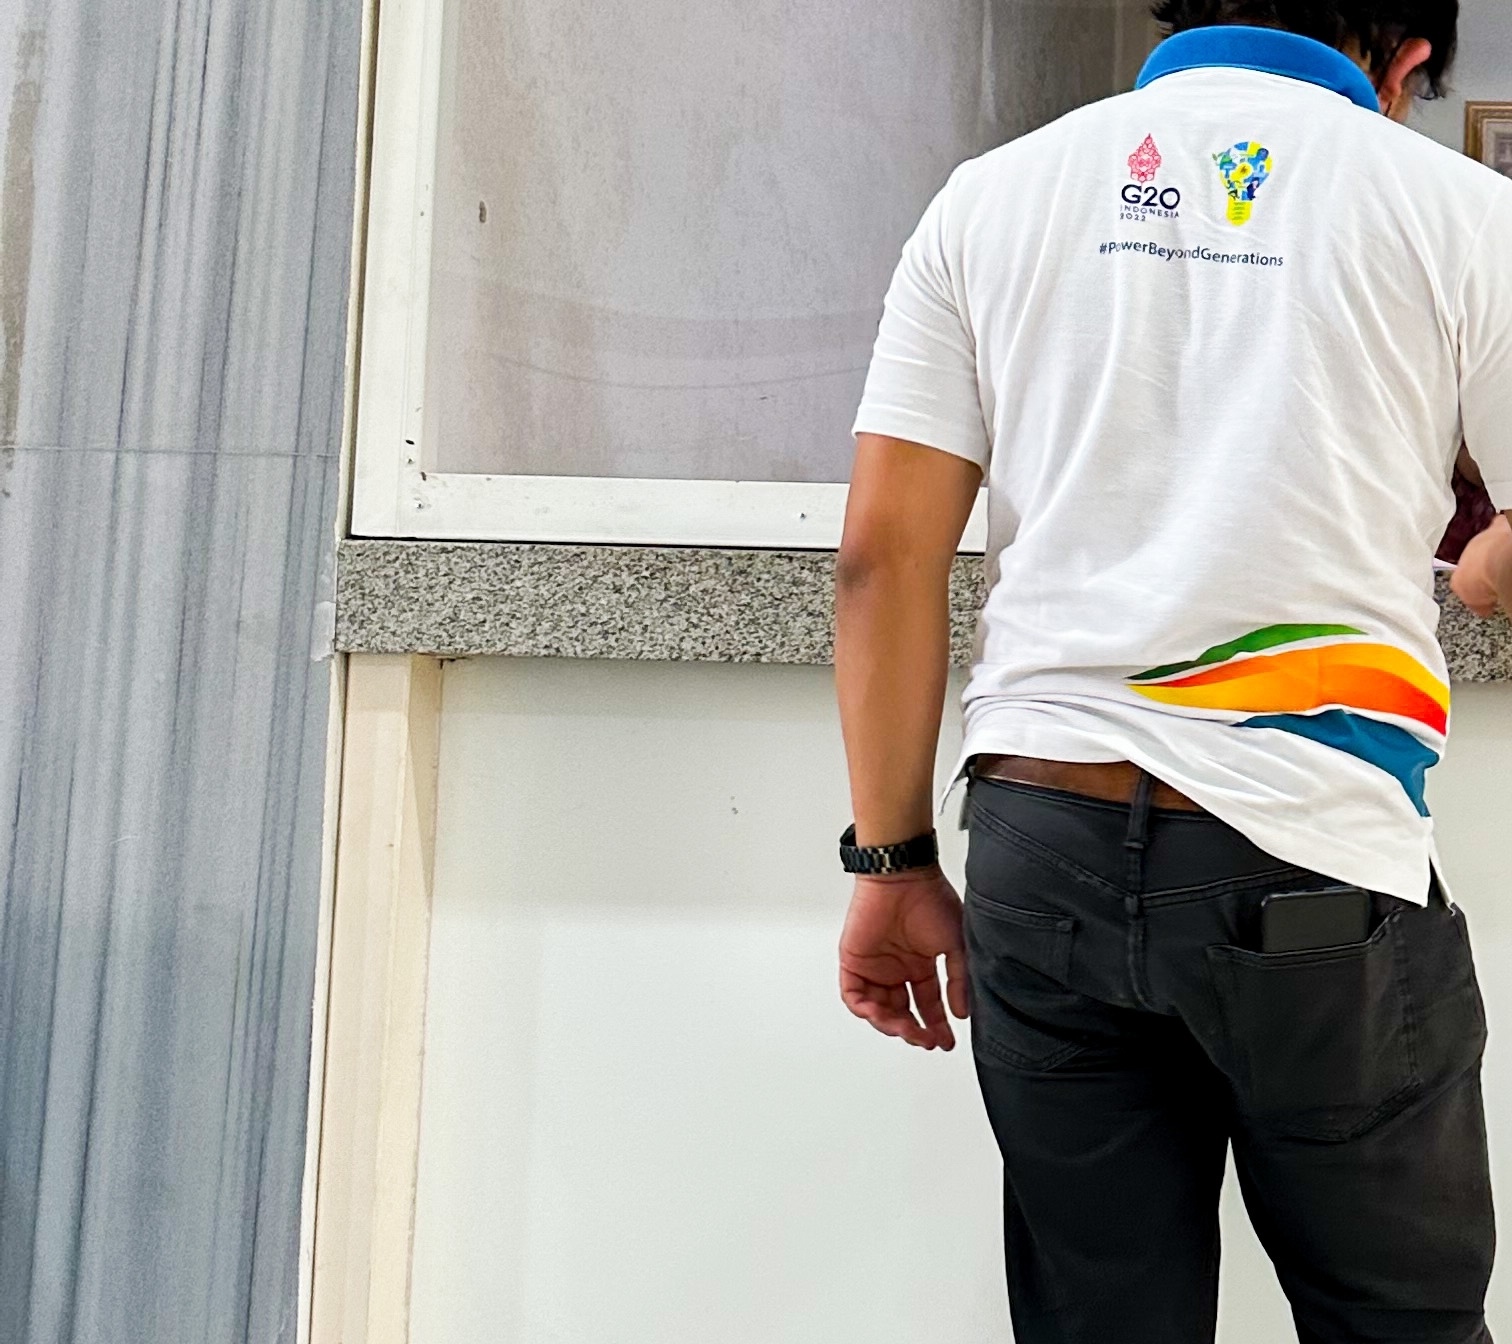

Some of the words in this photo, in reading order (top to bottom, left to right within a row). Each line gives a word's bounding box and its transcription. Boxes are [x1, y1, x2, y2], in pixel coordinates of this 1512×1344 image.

[1121, 184, 1180, 210] G20
[1119, 204, 1180, 219] INDONESIA
[1119, 212, 1146, 222] 2022
[1099, 241, 1284, 267] #PowerBeyondGenerations
